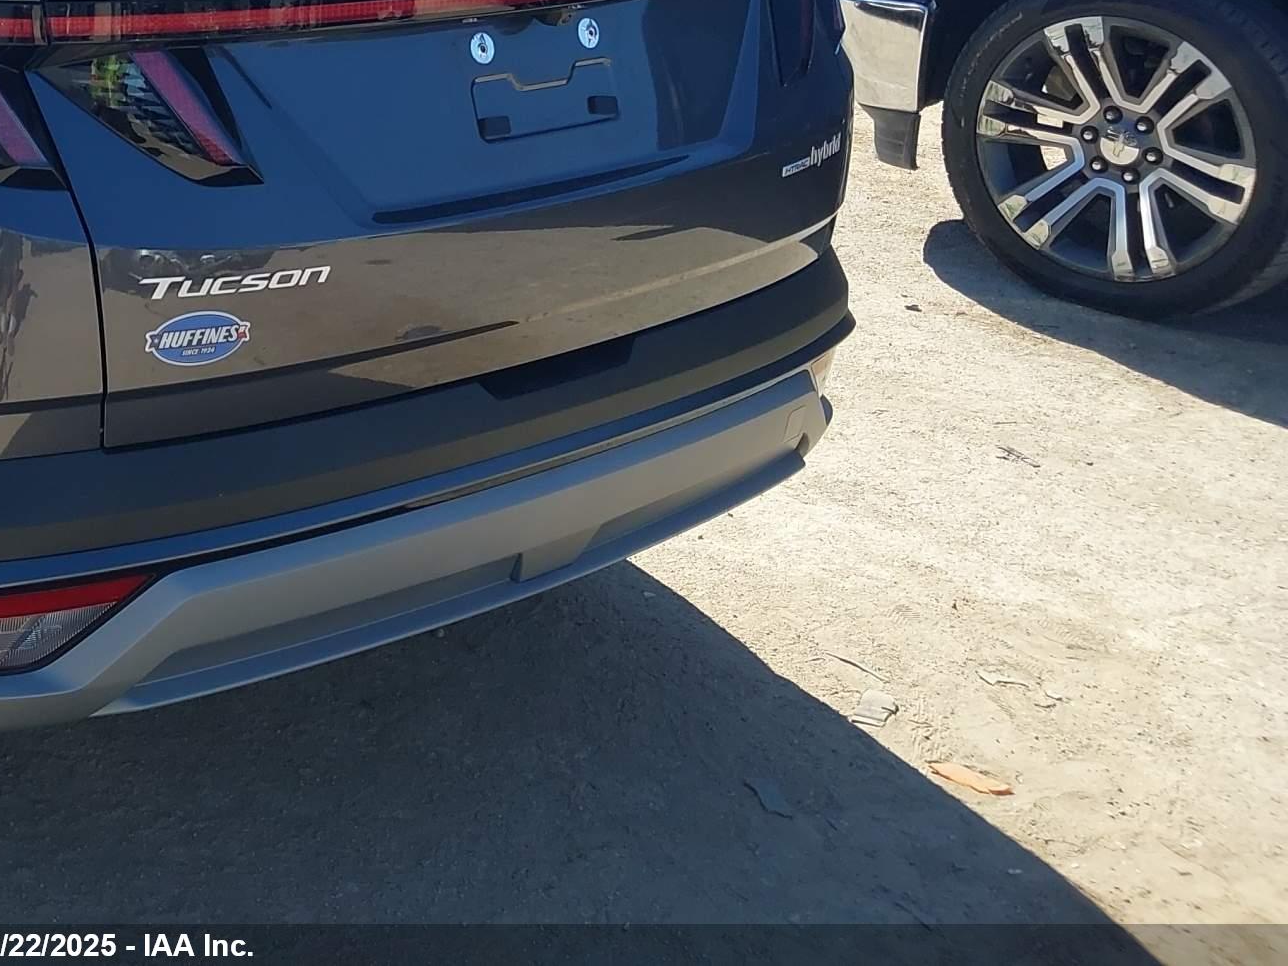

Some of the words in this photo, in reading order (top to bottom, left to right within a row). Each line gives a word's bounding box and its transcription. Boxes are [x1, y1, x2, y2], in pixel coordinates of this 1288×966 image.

[810, 132, 841, 167] hybrid
[158, 324, 240, 349] HUFFINES
[182, 347, 200, 357] SINCE
